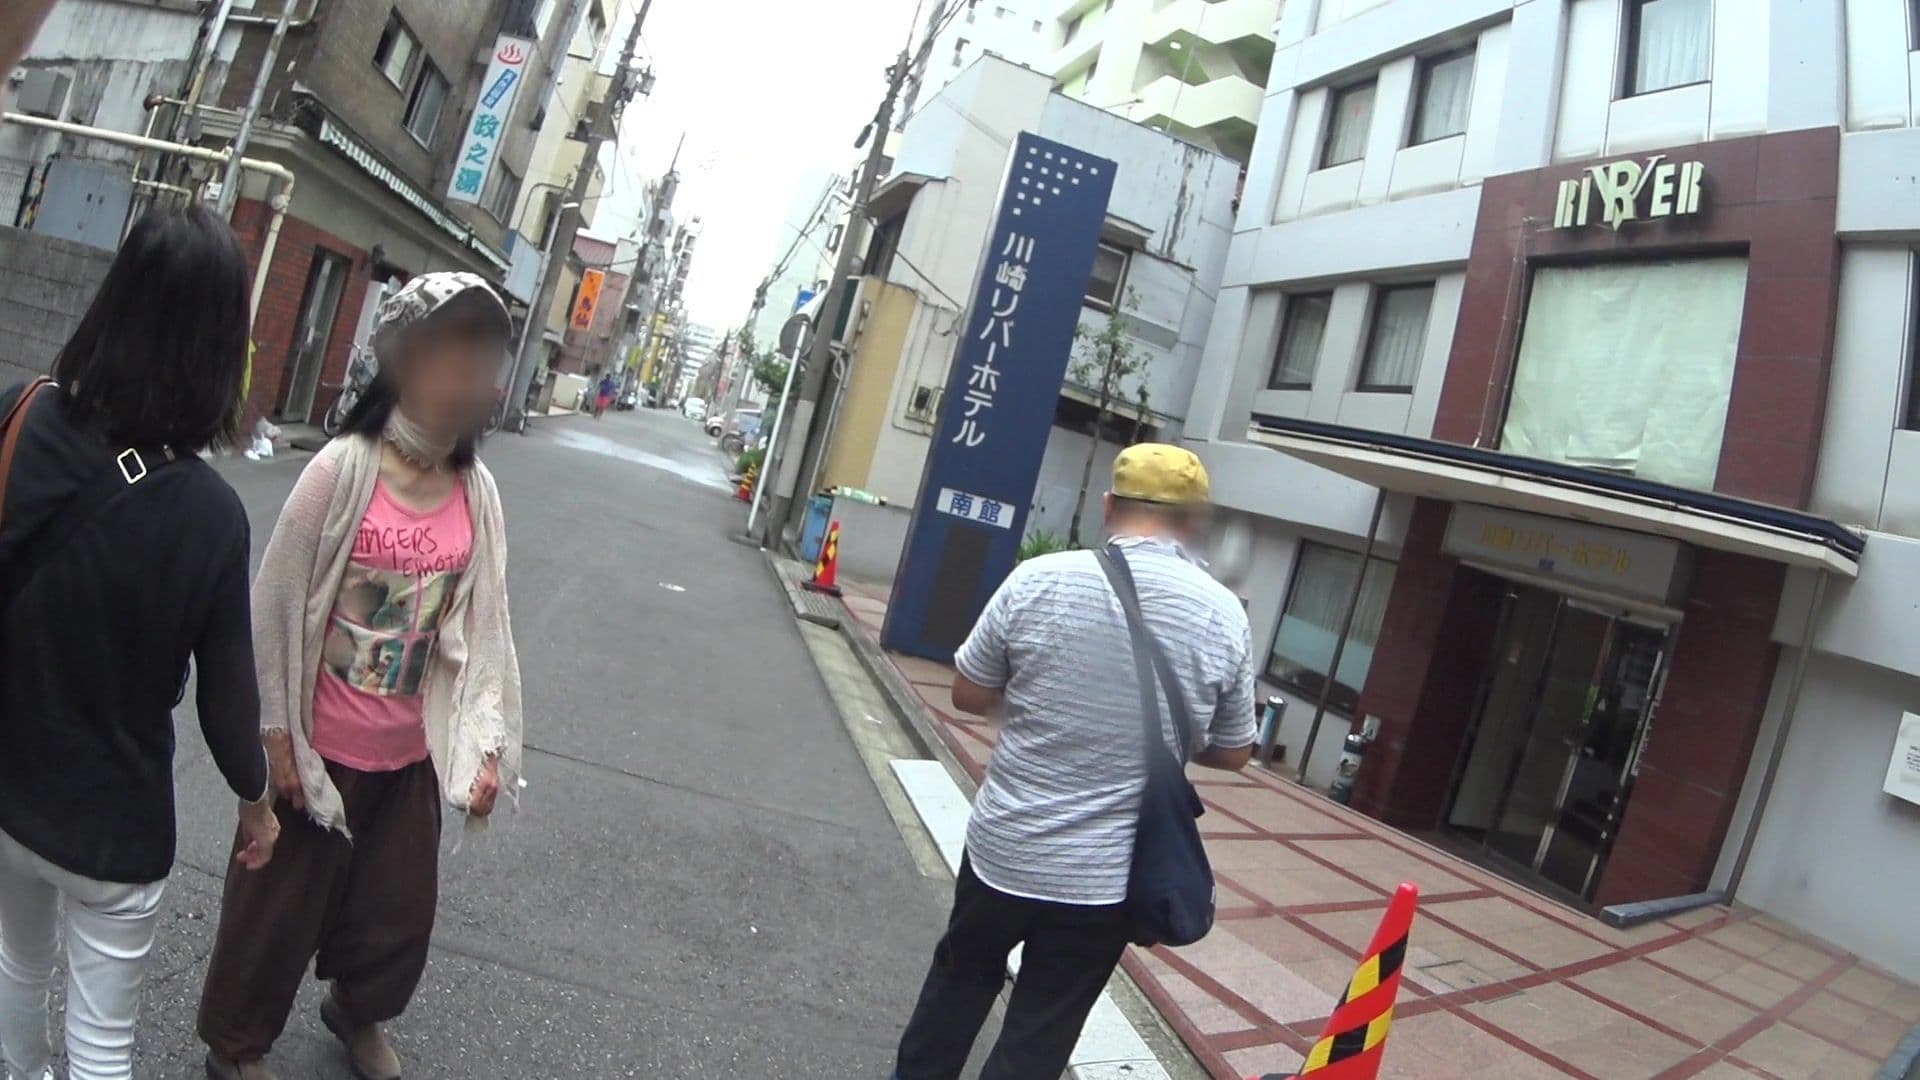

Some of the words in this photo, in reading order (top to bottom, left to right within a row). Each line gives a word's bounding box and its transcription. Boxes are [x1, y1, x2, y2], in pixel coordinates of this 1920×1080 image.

[953, 231, 1035, 447] 川崎リバーホテル
[950, 492, 1002, 523] 南館
[354, 519, 438, 571] INGERS
